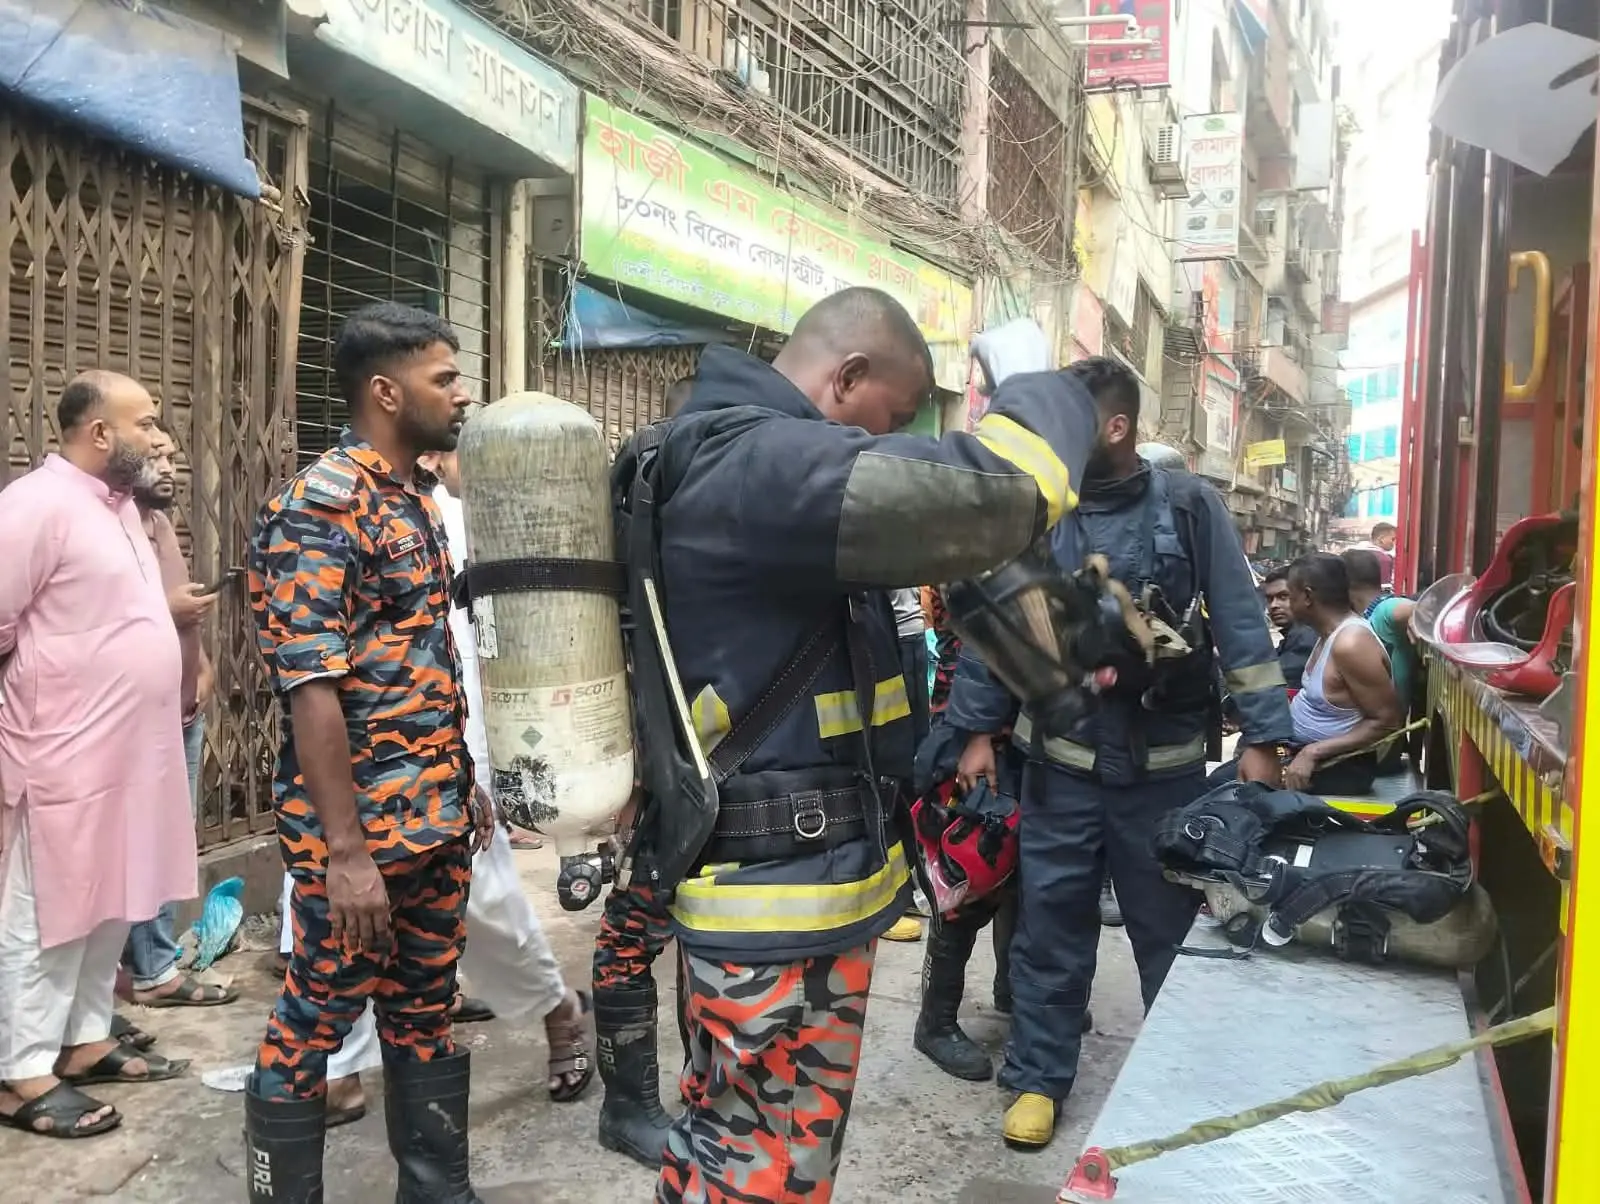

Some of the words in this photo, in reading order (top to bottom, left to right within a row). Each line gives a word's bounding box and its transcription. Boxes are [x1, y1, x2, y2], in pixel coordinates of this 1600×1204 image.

[593, 116, 692, 194] হাজী
[705, 179, 759, 222] এম
[686, 210, 743, 256] বিরেন
[490, 691, 529, 704] SCOTT
[574, 679, 615, 698] SCOTT
[598, 1034, 616, 1076] FIRE
[252, 1146, 273, 1197] FIRE
